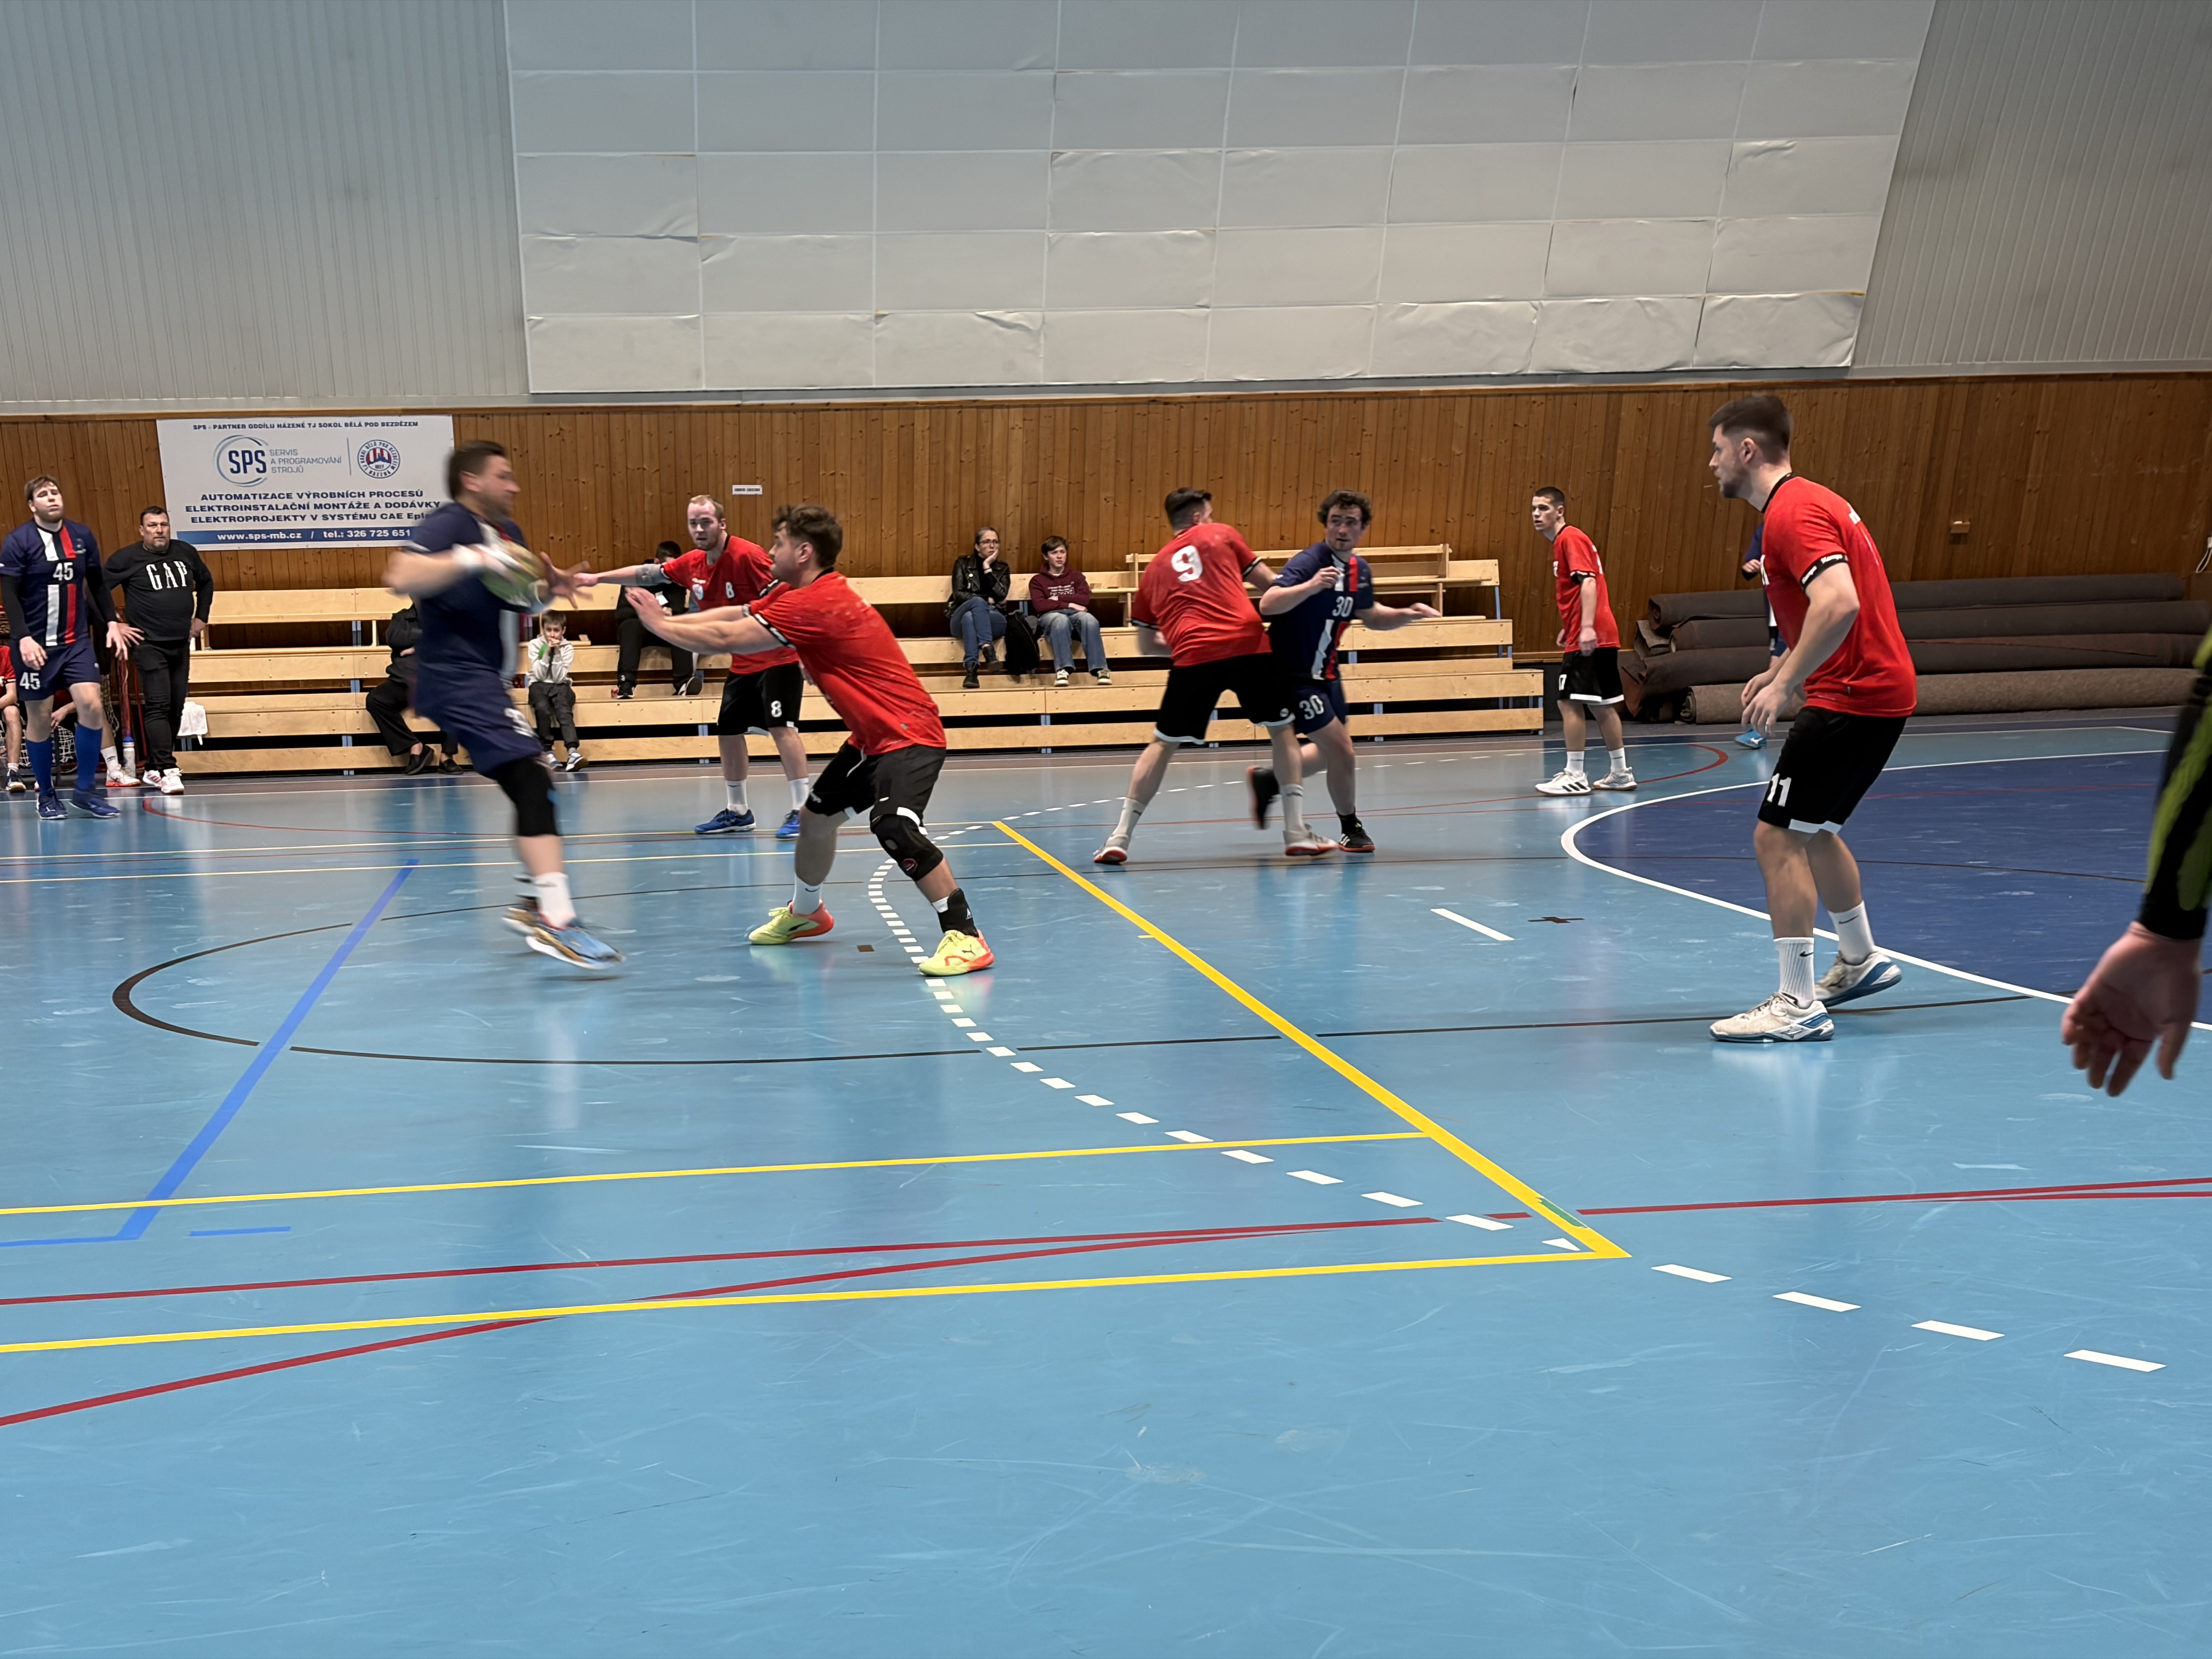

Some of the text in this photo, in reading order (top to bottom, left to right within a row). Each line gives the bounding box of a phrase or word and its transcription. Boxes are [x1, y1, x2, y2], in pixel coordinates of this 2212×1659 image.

[228, 450, 267, 474] SPS
[272, 465, 303, 473] STROJŮ
[278, 456, 342, 465] PROGRAMOVÁNÍ
[201, 489, 424, 501] AUTOMATIZACE VÝROBNÍCH PROCESŮ
[185, 502, 310, 512] ELEKTROINSTALAČNÍ
[314, 501, 370, 510] MONTÁŽE
[385, 500, 441, 509] DODÁVKY
[191, 515, 307, 523] ELEKTROPROJEKTY
[321, 512, 376, 521] SYSTÉMU
[217, 532, 302, 541] www.sps-mb.cz
[369, 529, 389, 538] 725
[53, 562, 74, 581] 45
[1171, 545, 1203, 582] 9
[146, 561, 188, 591] GAP
[1331, 596, 1353, 617] 30
[20, 672, 40, 690] 45
[771, 701, 782, 717] 8
[1299, 695, 1324, 720] 30
[1767, 773, 1792, 807] 11
